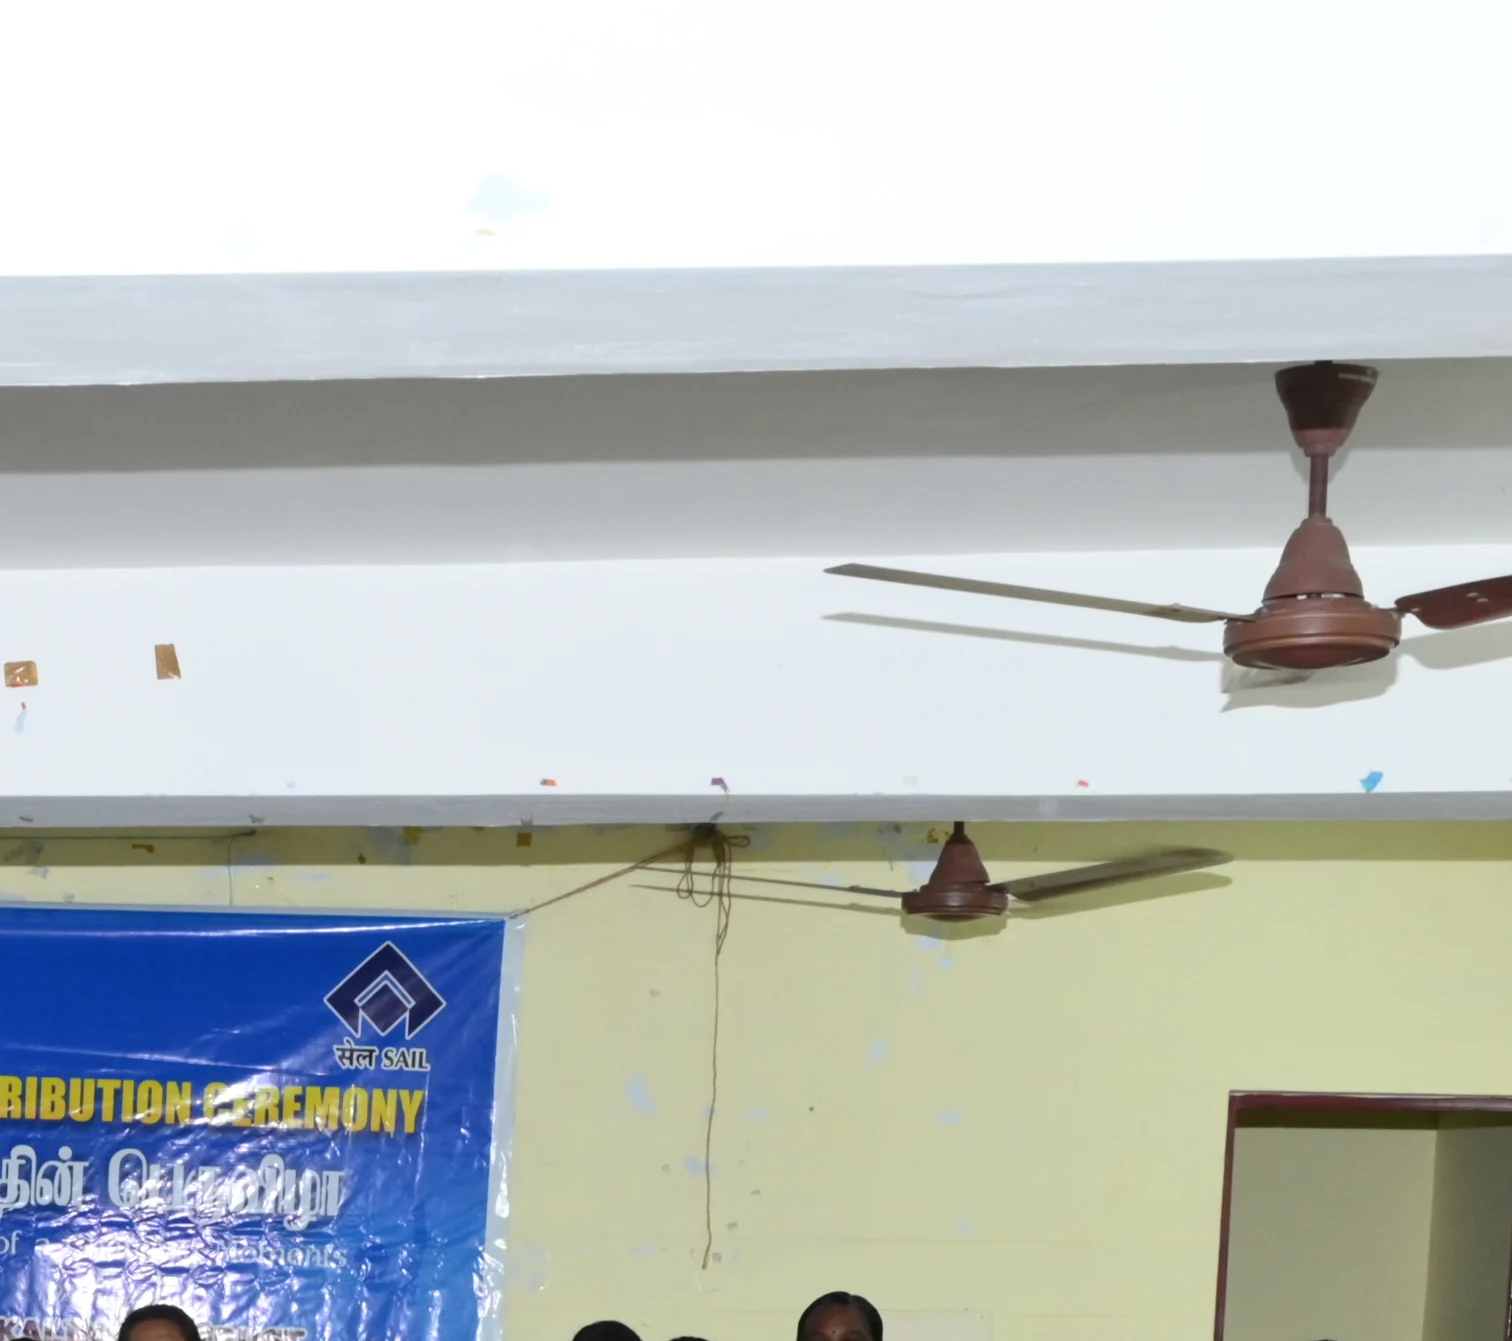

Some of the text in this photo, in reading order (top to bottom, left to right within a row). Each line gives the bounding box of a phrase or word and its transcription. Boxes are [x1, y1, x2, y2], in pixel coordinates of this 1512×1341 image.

[333, 1036, 379, 1070] सेल
[381, 1047, 431, 1071] SAIL
[202, 1080, 426, 1134] CEREMONY
